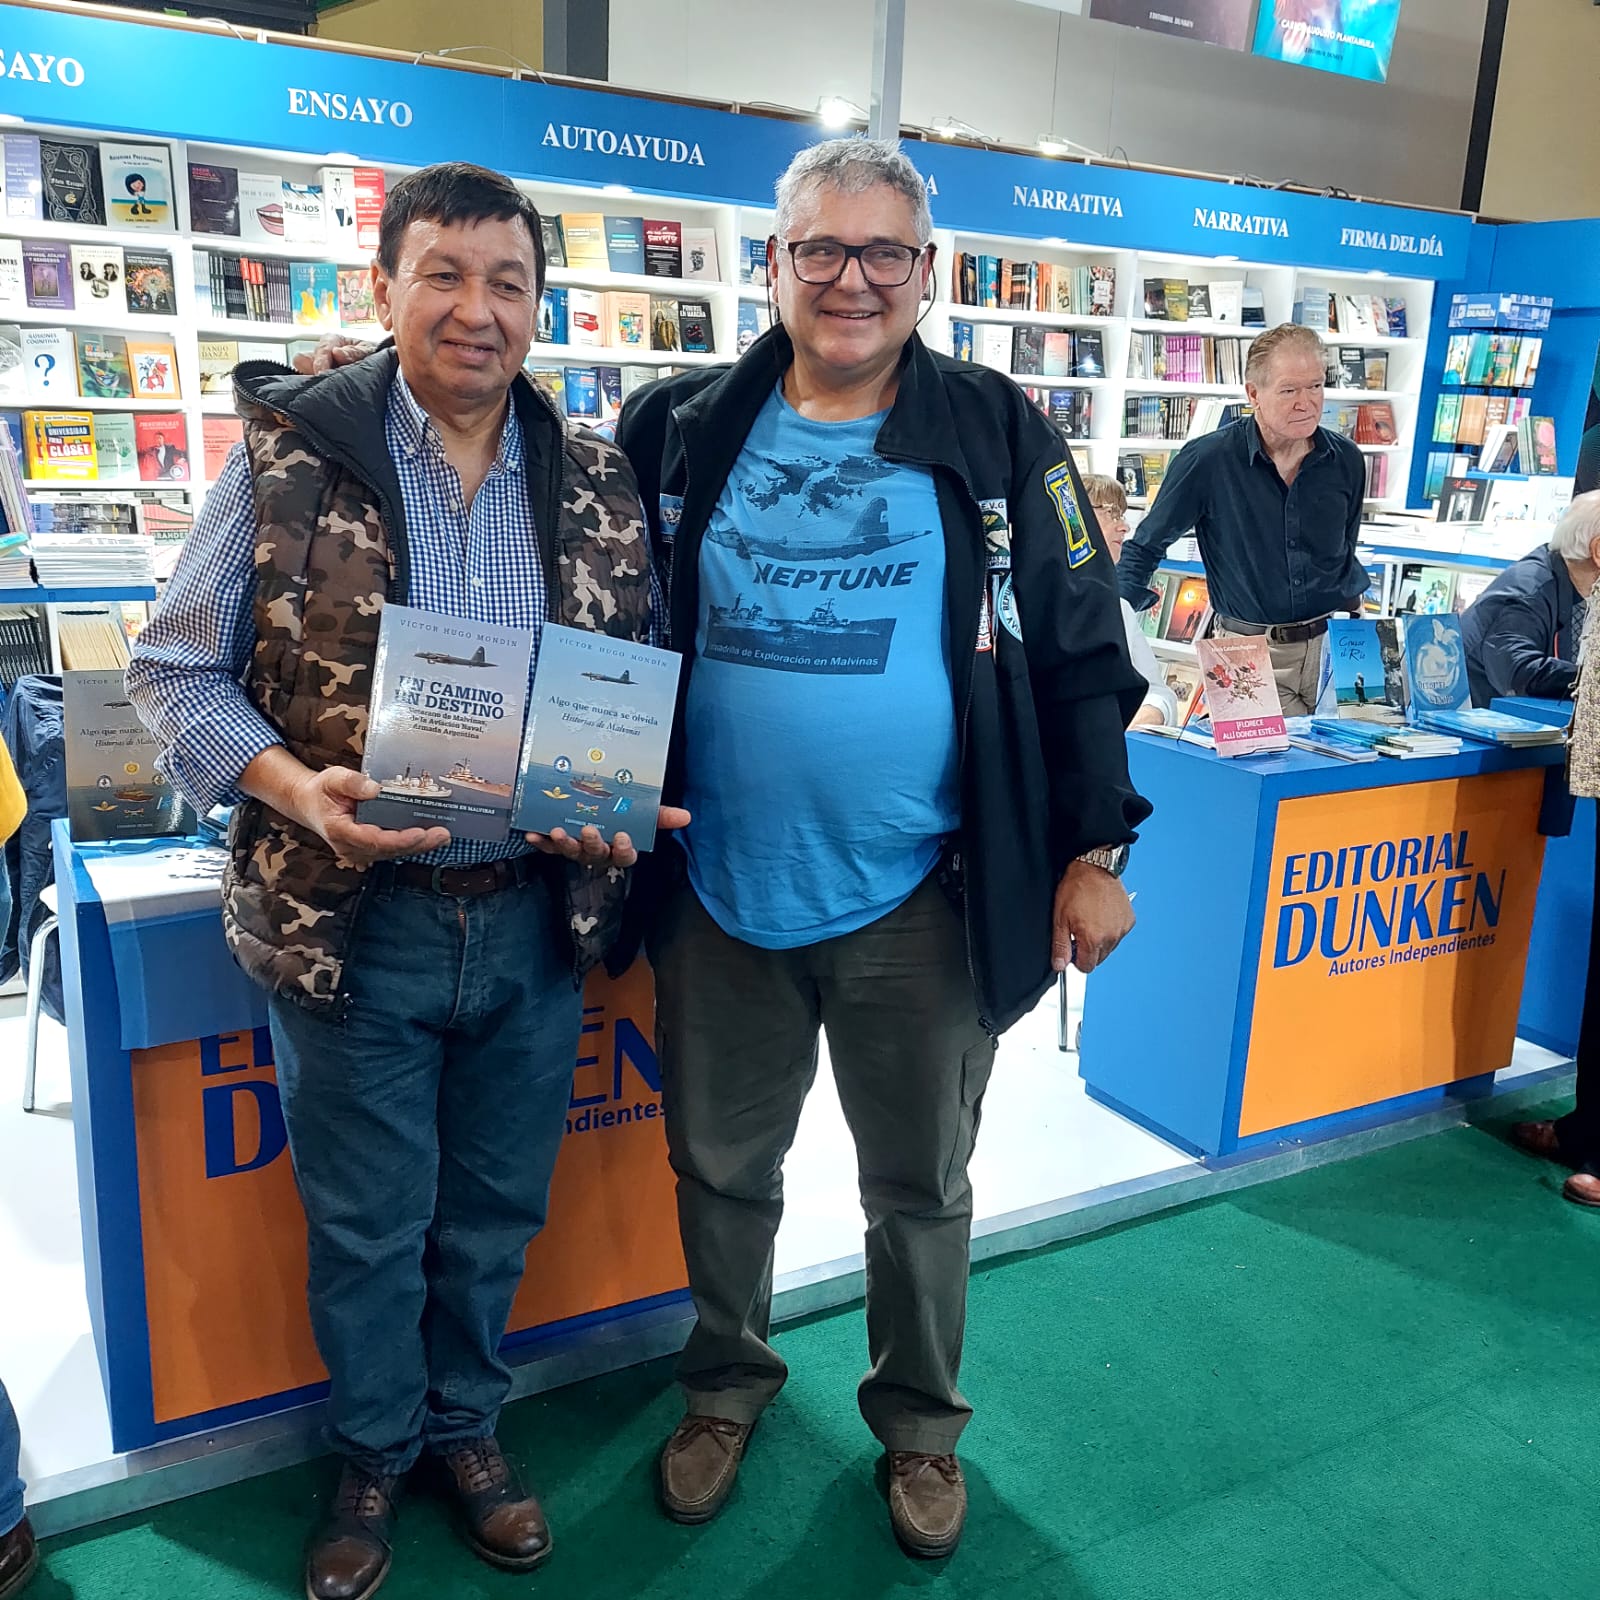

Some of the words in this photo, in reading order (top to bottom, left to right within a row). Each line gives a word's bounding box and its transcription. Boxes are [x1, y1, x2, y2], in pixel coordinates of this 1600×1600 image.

[287, 87, 413, 128] ENSAYO
[541, 122, 706, 167] AUTOAYUDA
[1012, 185, 1124, 218] NARRATIVA
[1193, 207, 1289, 238] NARRATIVA
[1340, 228, 1387, 250] FIRMA
[1389, 234, 1417, 254] DEL
[1418, 234, 1444, 257] DÍA
[753, 561, 920, 591] NEPTUNE
[443, 628, 472, 639] HUGO
[599, 647, 625, 657] HUGO
[754, 650, 811, 666] Exploración
[830, 656, 879, 666] Malvinas
[394, 689, 421, 706] N
[424, 694, 504, 720] DESTINO
[430, 681, 504, 705] CAMINO
[548, 695, 571, 709] Algo
[572, 702, 590, 713] que
[592, 705, 618, 718] nunca
[621, 712, 631, 720] se
[632, 712, 659, 726] olvida
[1281, 830, 1475, 898] EDITORIAL
[1273, 868, 1506, 969] DUNKEN
[1328, 955, 1386, 977] Autores
[1389, 931, 1496, 965] Independientes
